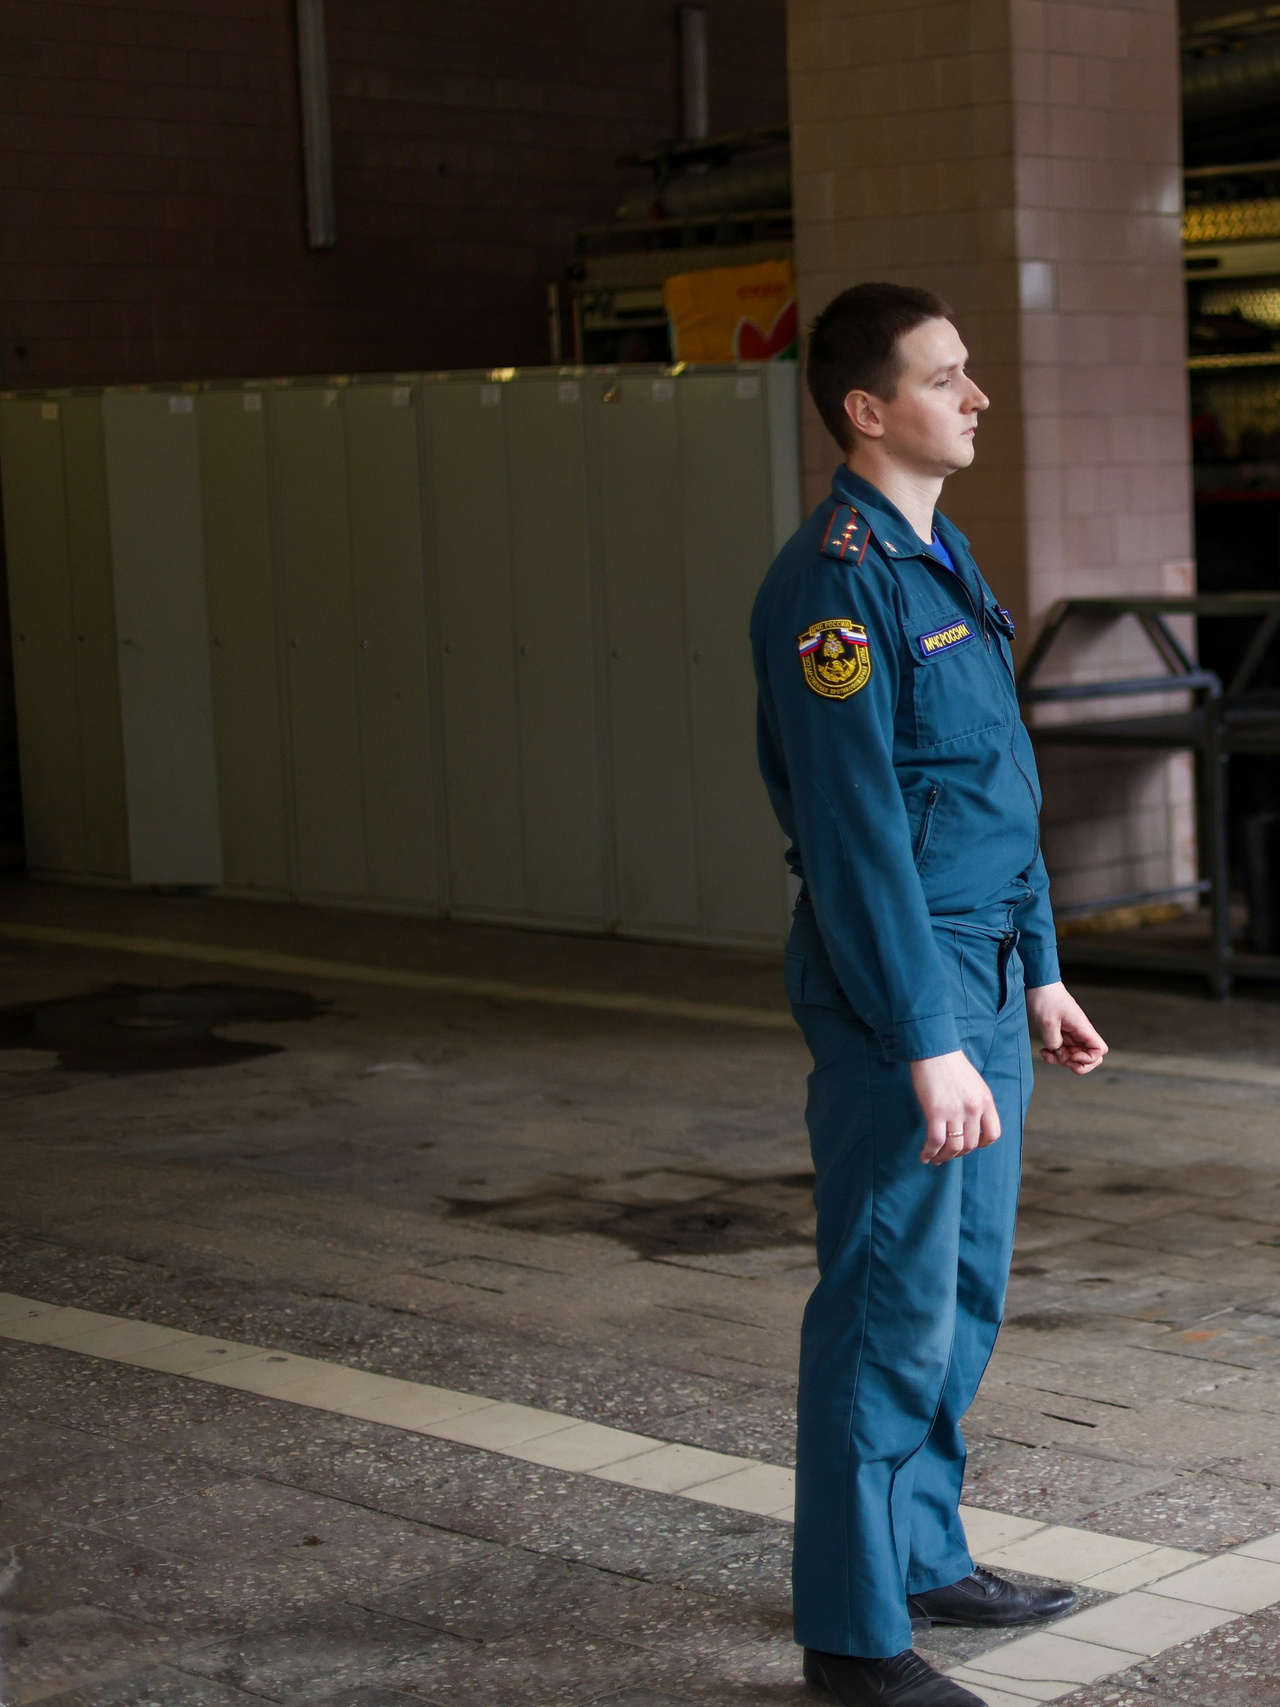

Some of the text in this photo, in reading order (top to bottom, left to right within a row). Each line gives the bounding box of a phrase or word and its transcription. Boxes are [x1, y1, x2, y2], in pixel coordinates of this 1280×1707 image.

[825, 621, 850, 629] РОССИИ
[924, 623, 970, 652] МЧС РОССИИ
